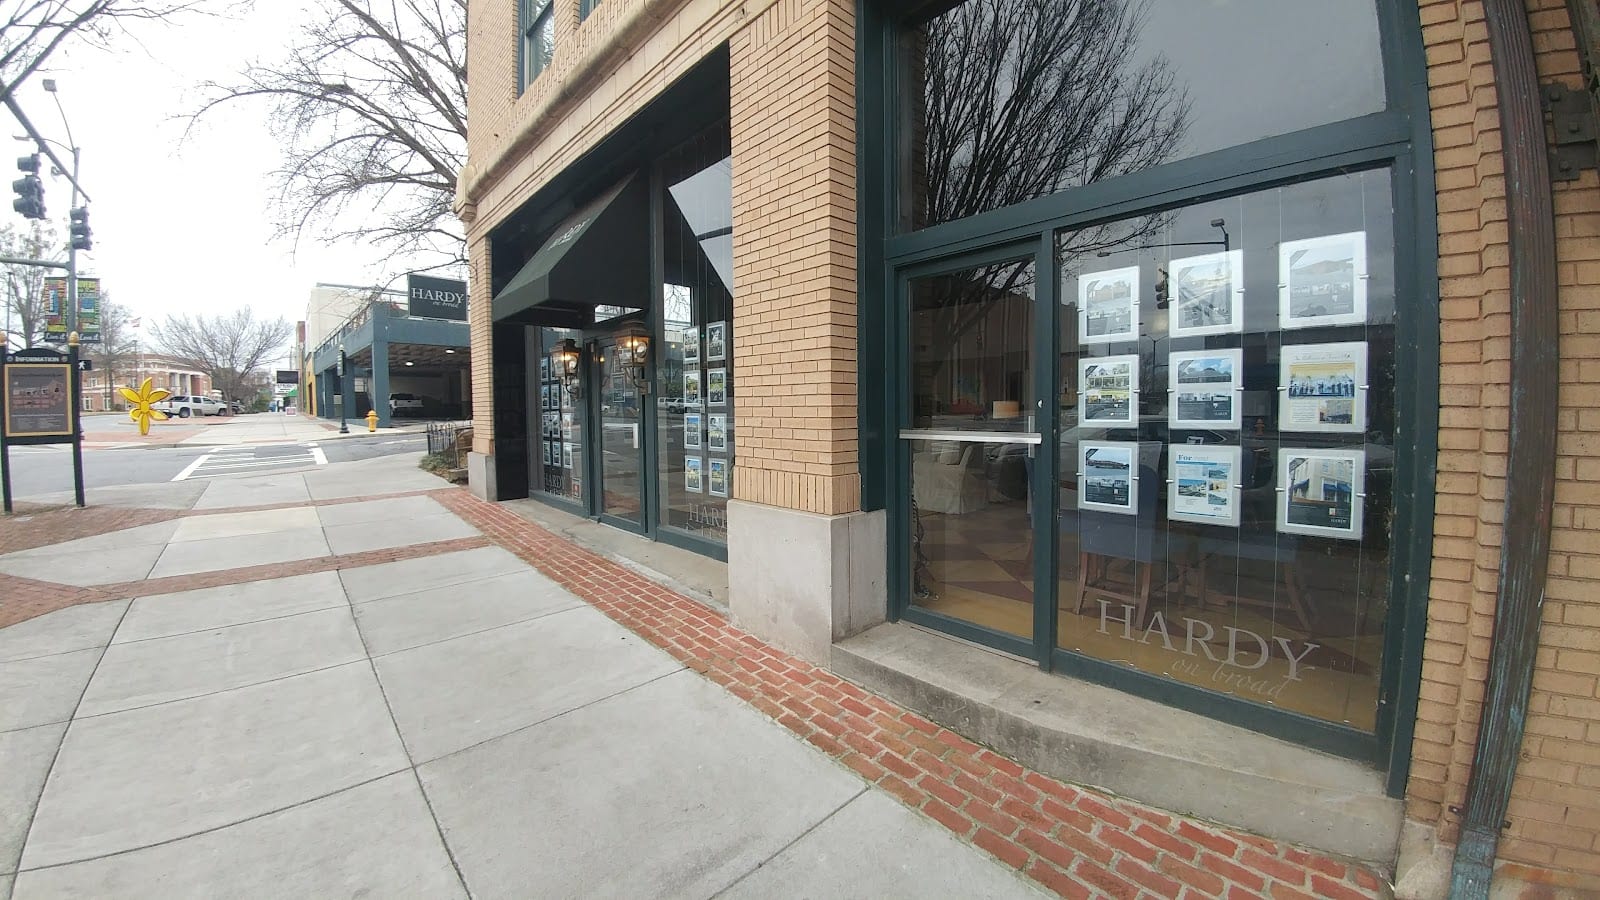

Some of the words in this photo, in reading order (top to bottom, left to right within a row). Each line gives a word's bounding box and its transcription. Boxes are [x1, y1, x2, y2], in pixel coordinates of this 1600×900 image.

[411, 287, 464, 304] HARDY
[1096, 599, 1320, 681] HARDY
[1171, 659, 1200, 676] on
[1211, 655, 1297, 699] broad
